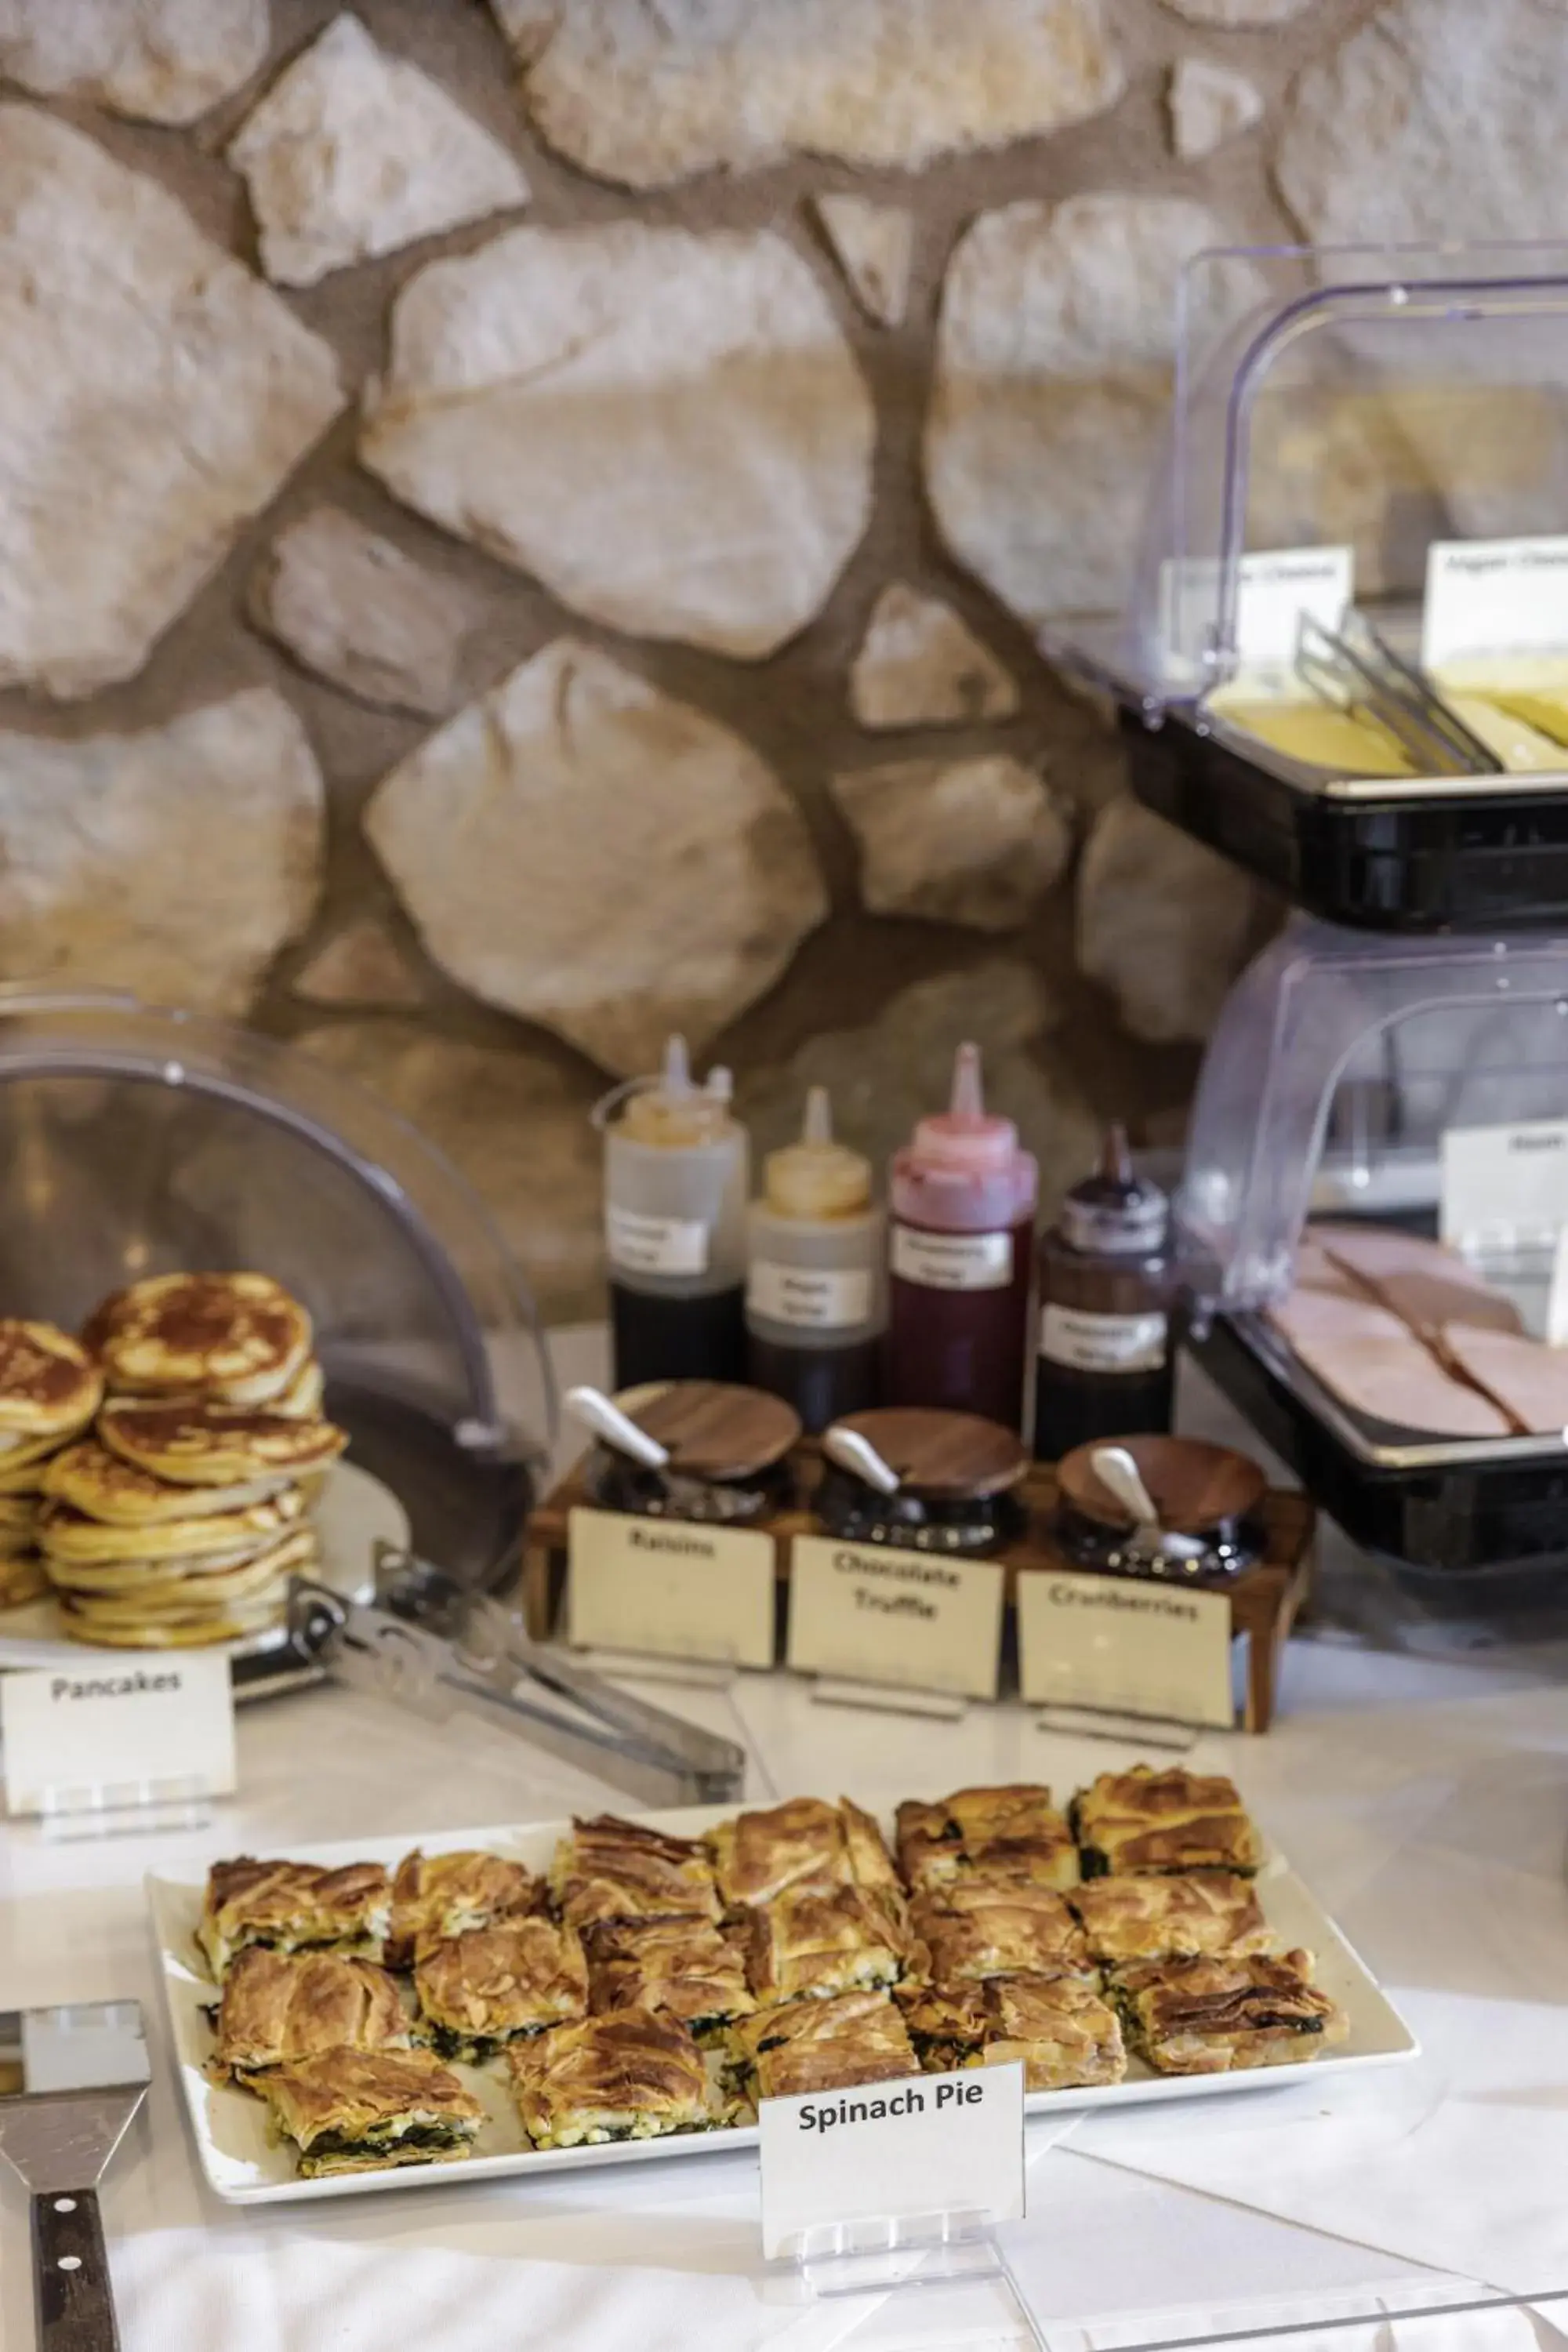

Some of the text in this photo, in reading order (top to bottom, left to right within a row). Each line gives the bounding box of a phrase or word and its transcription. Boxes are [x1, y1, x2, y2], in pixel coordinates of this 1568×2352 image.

[630, 1527, 716, 1559] Raisins
[833, 1550, 961, 1588] Chocolate
[853, 1586, 938, 1621] Truffle
[1048, 1581, 1198, 1623] Cranberries
[51, 1670, 181, 1702] Pancakes
[799, 2082, 983, 2133] Spinach Pie
